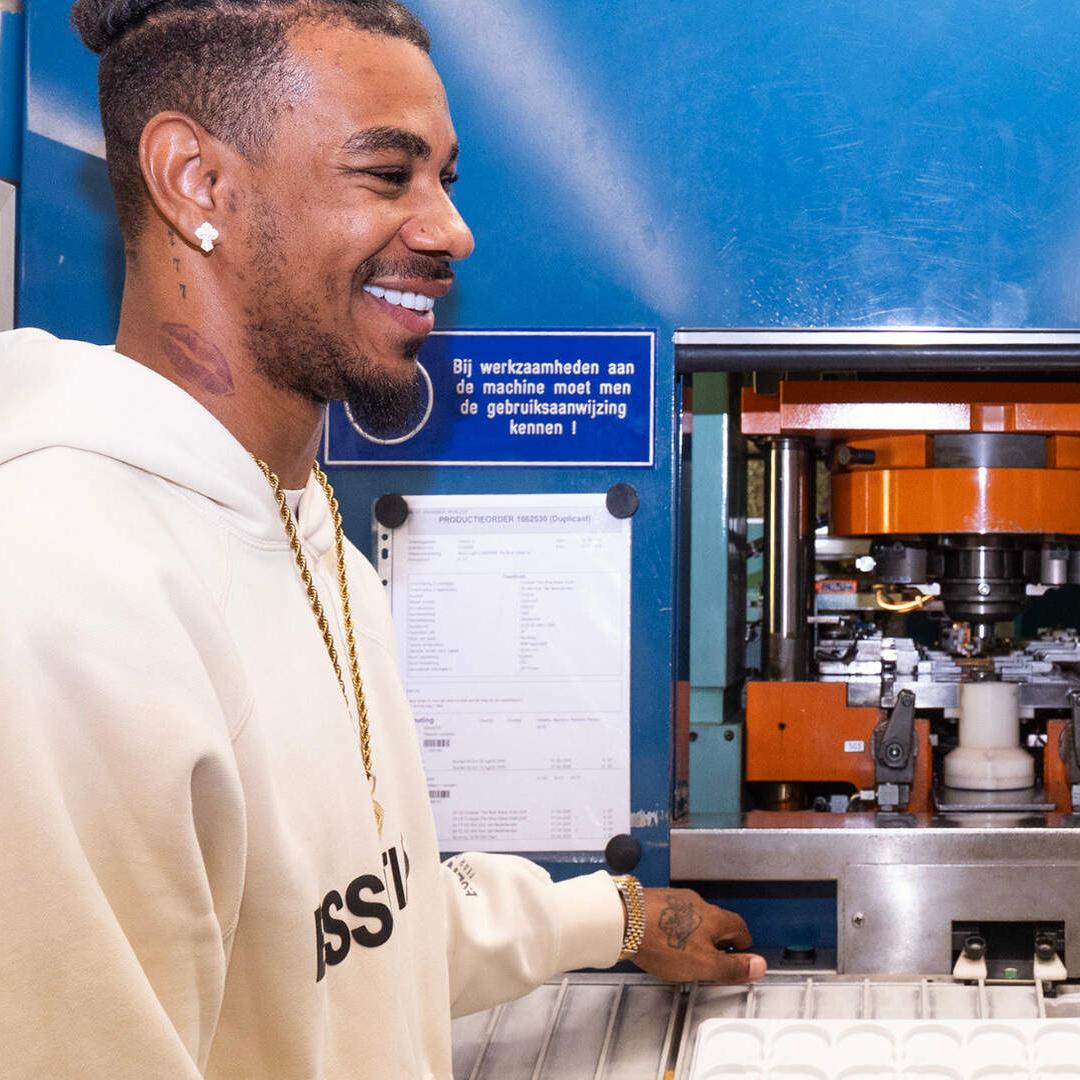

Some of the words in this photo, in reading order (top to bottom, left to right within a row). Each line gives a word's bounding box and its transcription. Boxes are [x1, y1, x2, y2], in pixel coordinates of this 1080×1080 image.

[452, 358, 472, 377] Bij
[480, 359, 600, 375] werkzaamheden
[607, 362, 635, 375] aan
[456, 379, 474, 395] de
[482, 379, 545, 395] machine
[554, 380, 591, 395] moet
[599, 382, 631, 395] men
[460, 399, 478, 415] de
[487, 399, 627, 419] gebruiksaanwijzing
[510, 419, 563, 435] kennen
[438, 515, 514, 524] PRODUCTIEORDER
